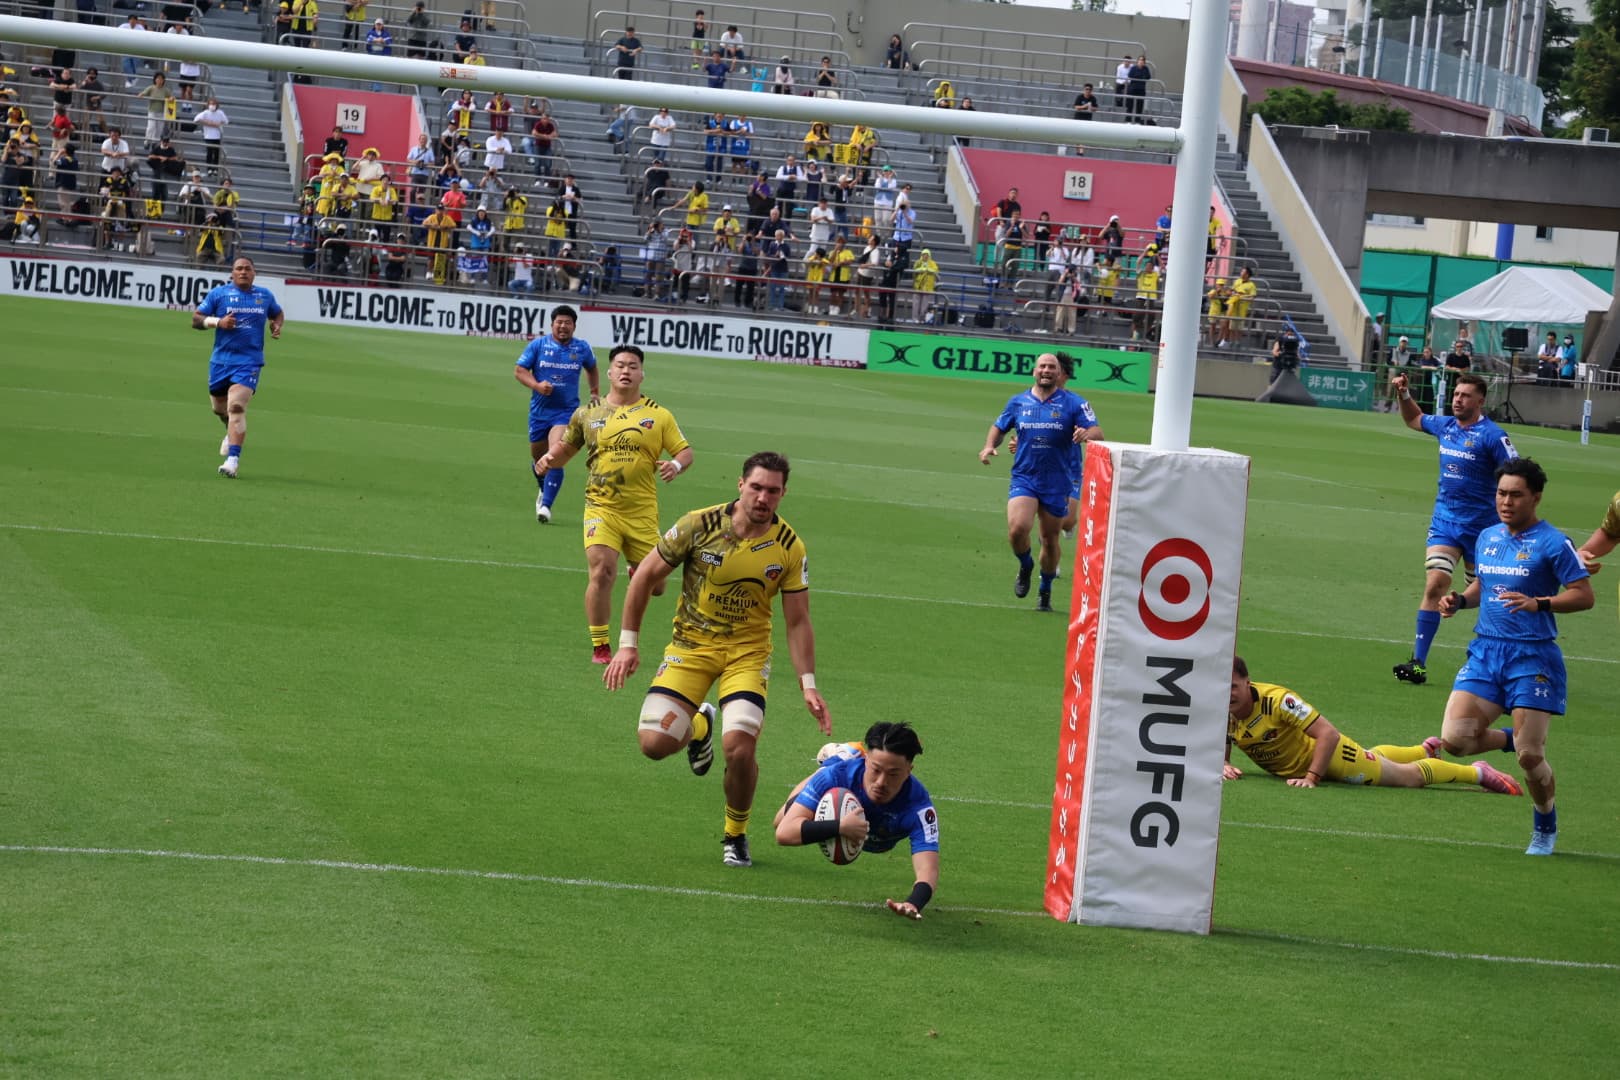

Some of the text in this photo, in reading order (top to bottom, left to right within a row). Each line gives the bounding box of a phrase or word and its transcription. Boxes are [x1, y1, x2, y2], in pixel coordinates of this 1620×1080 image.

[343, 109, 360, 121] 19
[1071, 176, 1086, 188] 18
[10, 260, 134, 301] WELCOME
[136, 282, 156, 302] TO
[226, 306, 265, 314] Panasonic
[317, 288, 547, 336] WELCOME TO RUGBY!
[611, 314, 833, 359] WELCOME TO RUGBY!
[540, 360, 580, 370] Panasonic
[931, 346, 1083, 380] GILBET
[1308, 374, 1349, 390] 非常口
[1019, 421, 1064, 431] Panasonic
[1478, 563, 1530, 577] Panasonic
[708, 592, 760, 609] PREMIUM
[1130, 655, 1194, 849] MUFG
